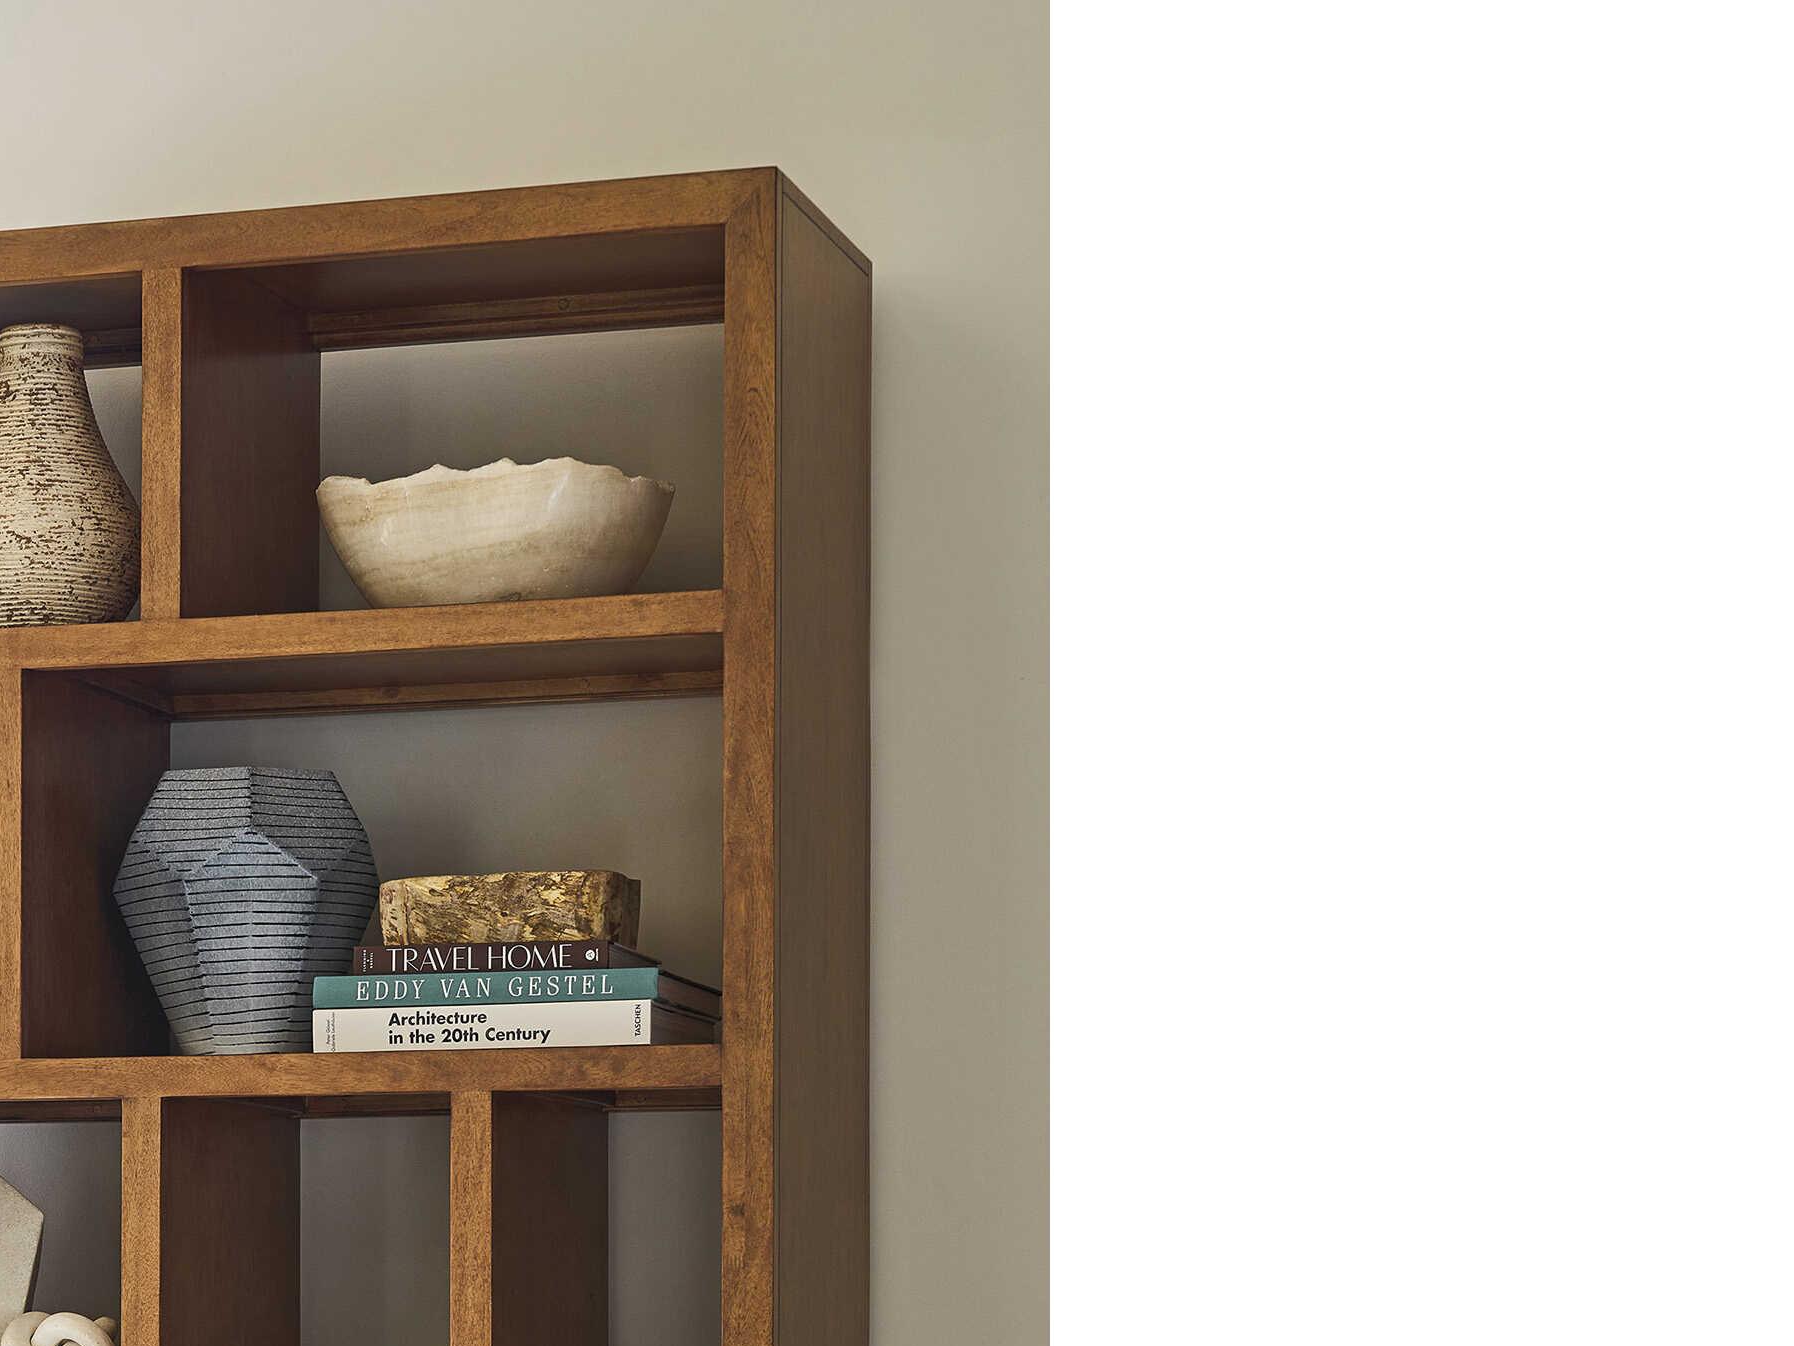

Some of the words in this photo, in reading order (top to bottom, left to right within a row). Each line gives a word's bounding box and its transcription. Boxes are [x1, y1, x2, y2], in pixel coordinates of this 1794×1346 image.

[386, 946, 479, 972] TRAVEL
[487, 943, 573, 970] HOME
[356, 979, 425, 1000] EDDY
[439, 977, 491, 998] VAN
[508, 974, 614, 997] GESTEL
[388, 1010, 487, 1027] Architecture
[634, 1004, 642, 1037] TASCHEN
[388, 1030, 403, 1044] in
[409, 1029, 435, 1044] the
[441, 1027, 479, 1042] 20th
[485, 1027, 551, 1043] Century
